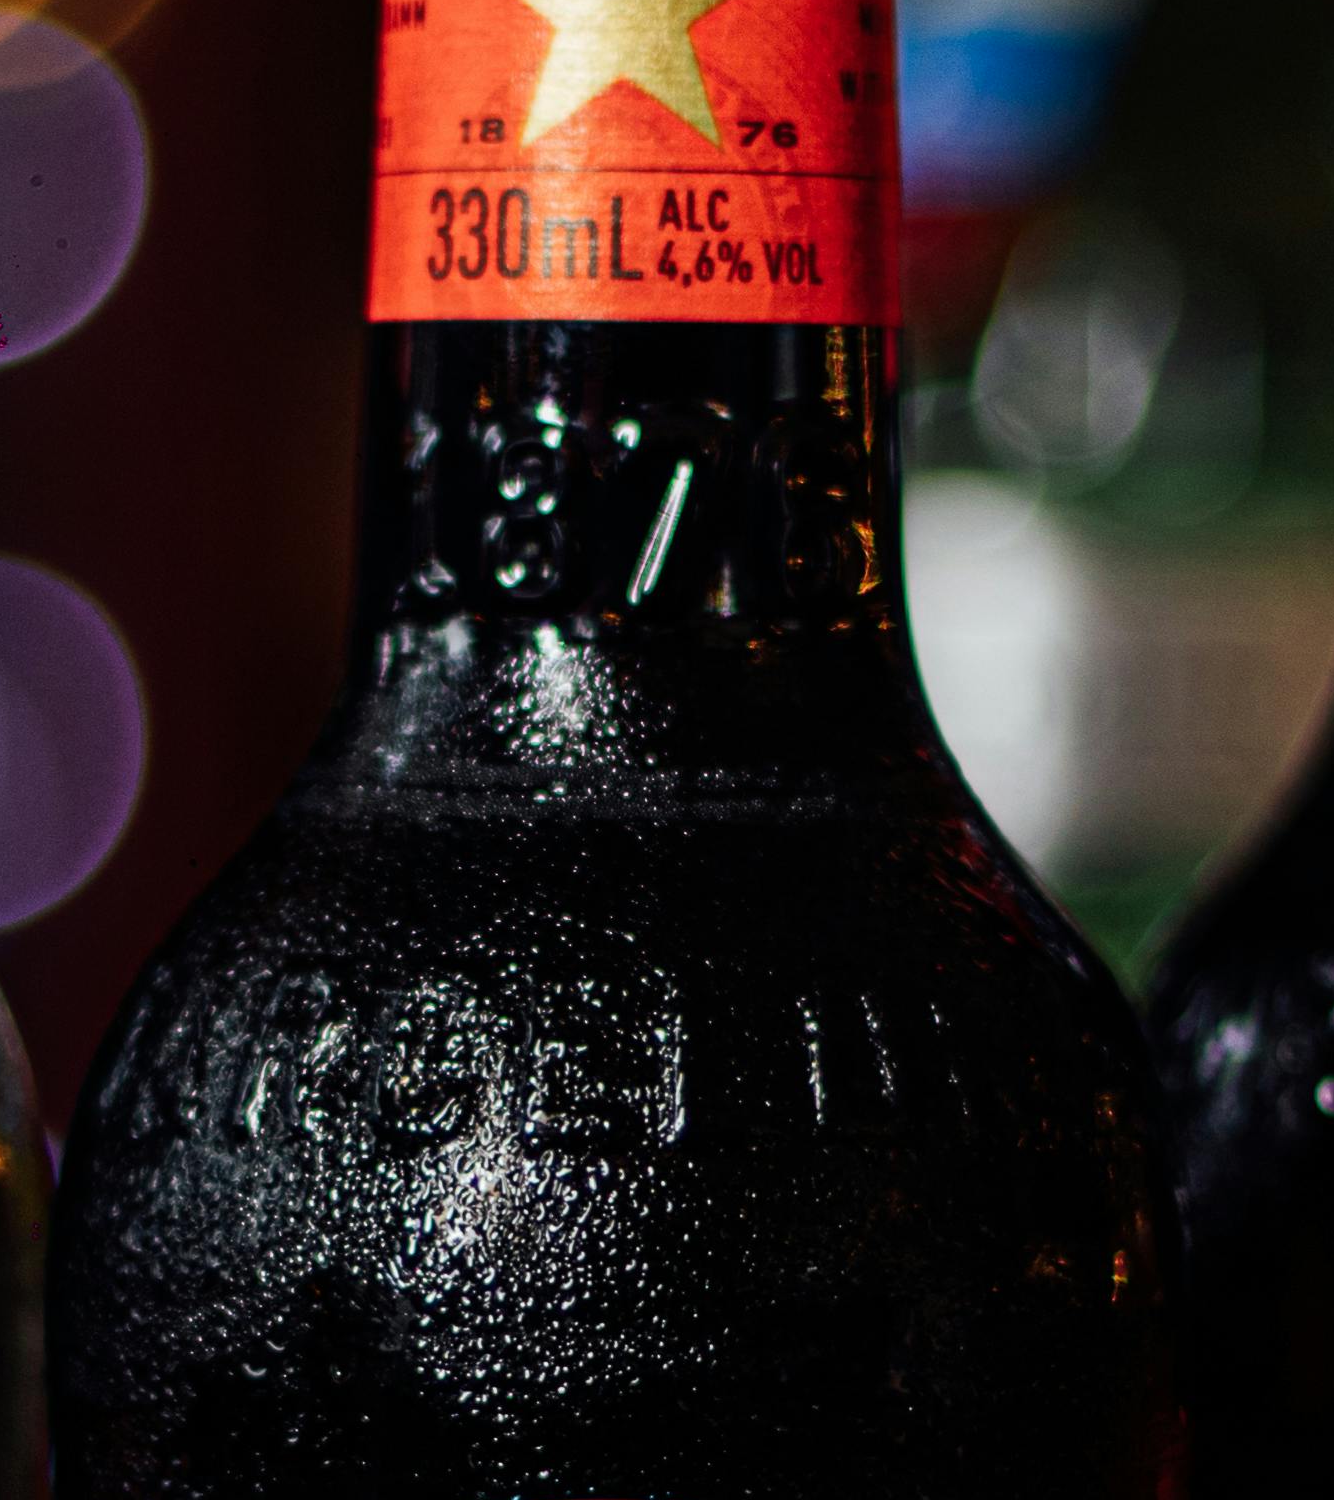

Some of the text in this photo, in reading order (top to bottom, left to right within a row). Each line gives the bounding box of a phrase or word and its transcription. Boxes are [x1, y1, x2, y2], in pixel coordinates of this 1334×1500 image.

[461, 117, 798, 148] 18 76
[658, 189, 730, 233] ALC
[764, 243, 824, 286] VOL
